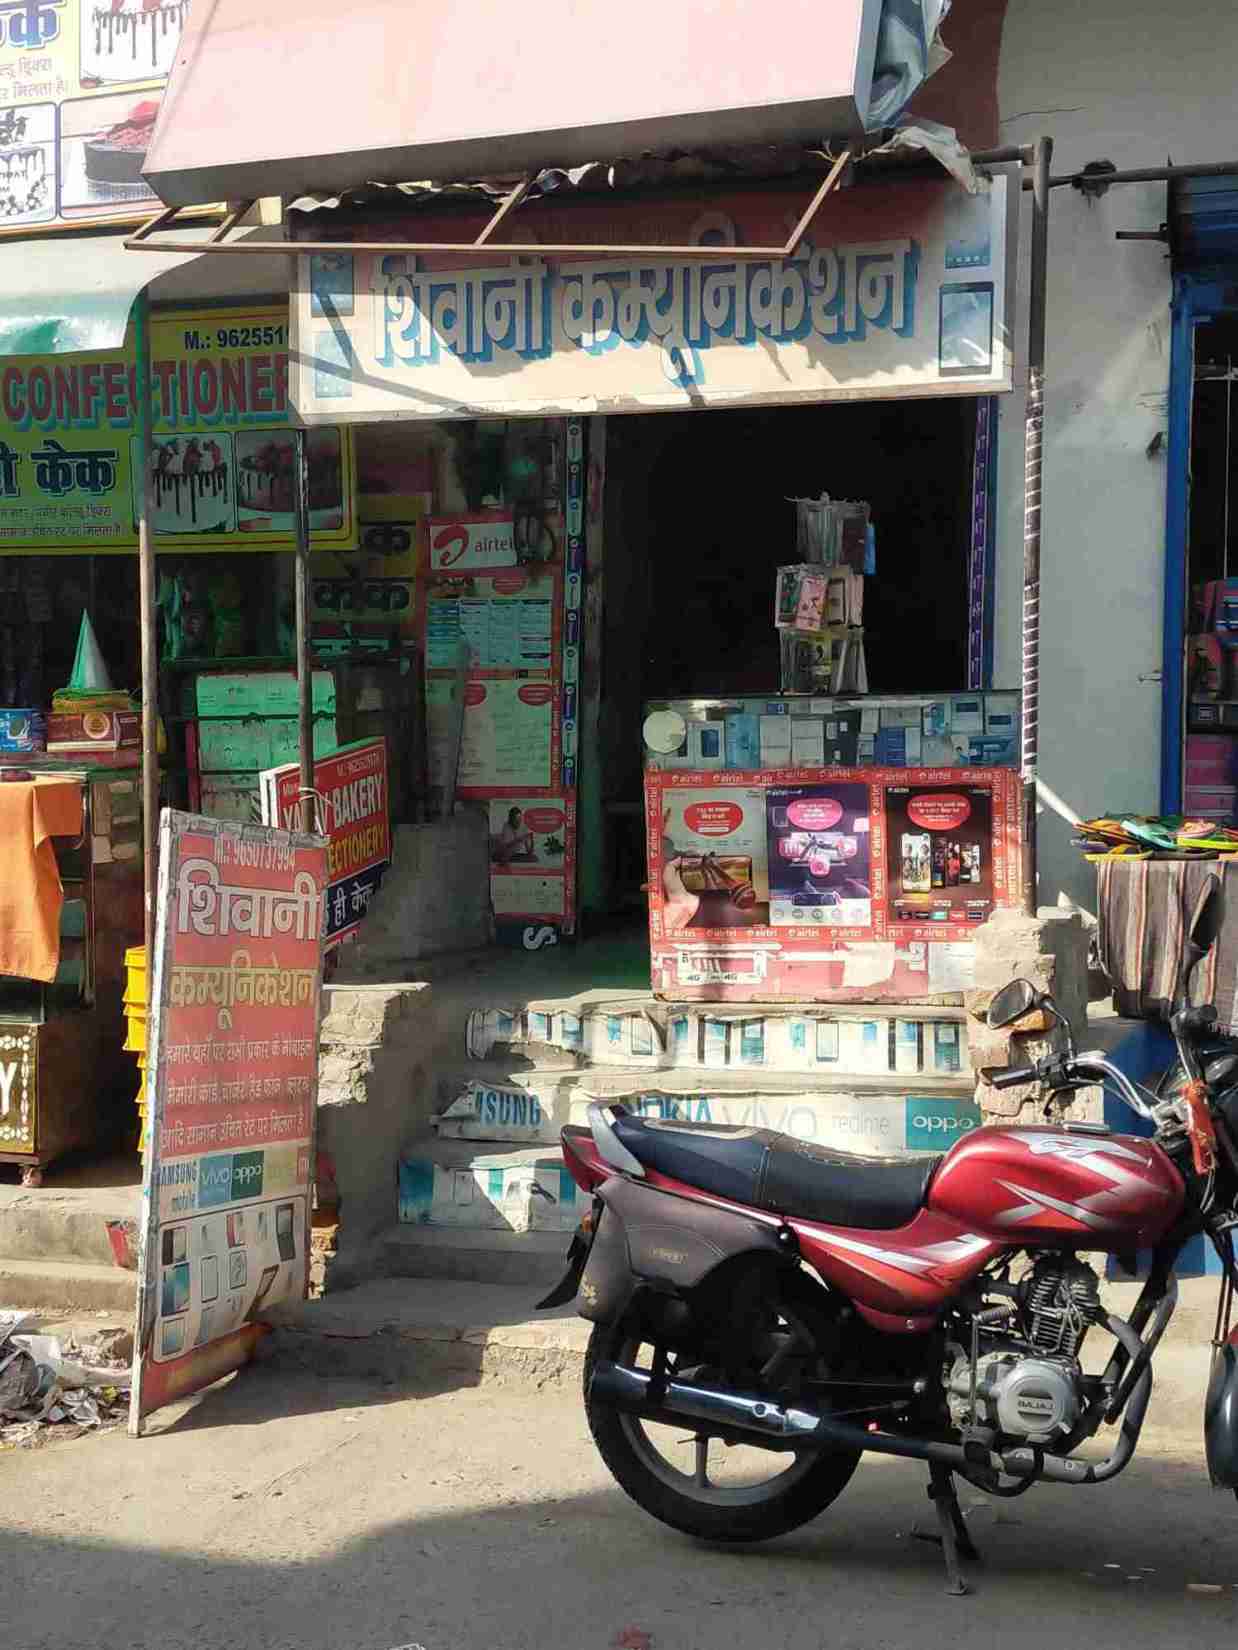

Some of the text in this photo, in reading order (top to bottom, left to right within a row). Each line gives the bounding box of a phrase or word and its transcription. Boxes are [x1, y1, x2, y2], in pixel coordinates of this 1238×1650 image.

[369, 230, 552, 362] शिवानी
[216, 325, 289, 349] 962551
[2, 353, 289, 427] CONFETIONER
[333, 773, 384, 828] BAKERY
[175, 857, 321, 941] शिवानी
[912, 1113, 975, 1134] oppo
[233, 1164, 263, 1185] oppo
